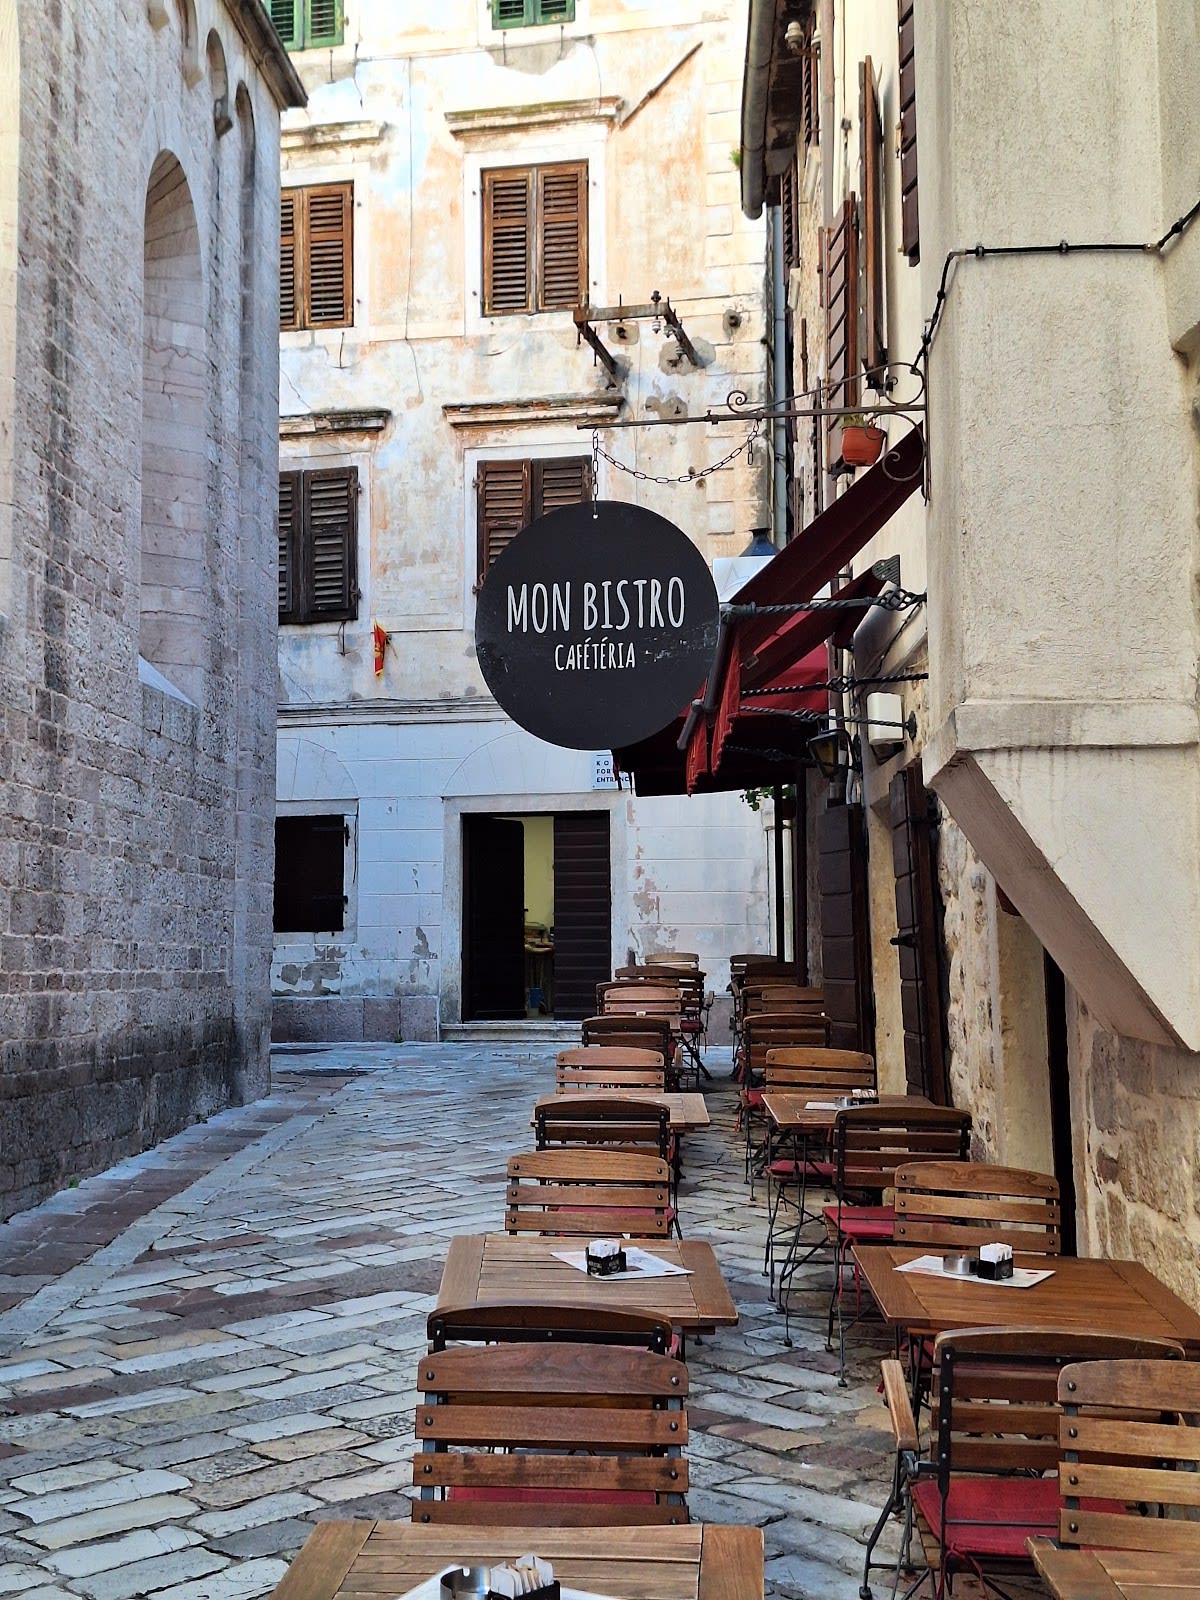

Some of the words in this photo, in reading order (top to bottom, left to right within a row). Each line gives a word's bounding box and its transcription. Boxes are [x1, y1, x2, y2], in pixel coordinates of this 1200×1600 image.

[507, 581, 571, 633] MON
[583, 576, 686, 631] BISTRO
[554, 636, 636, 671] CAFÉTÉRIA
